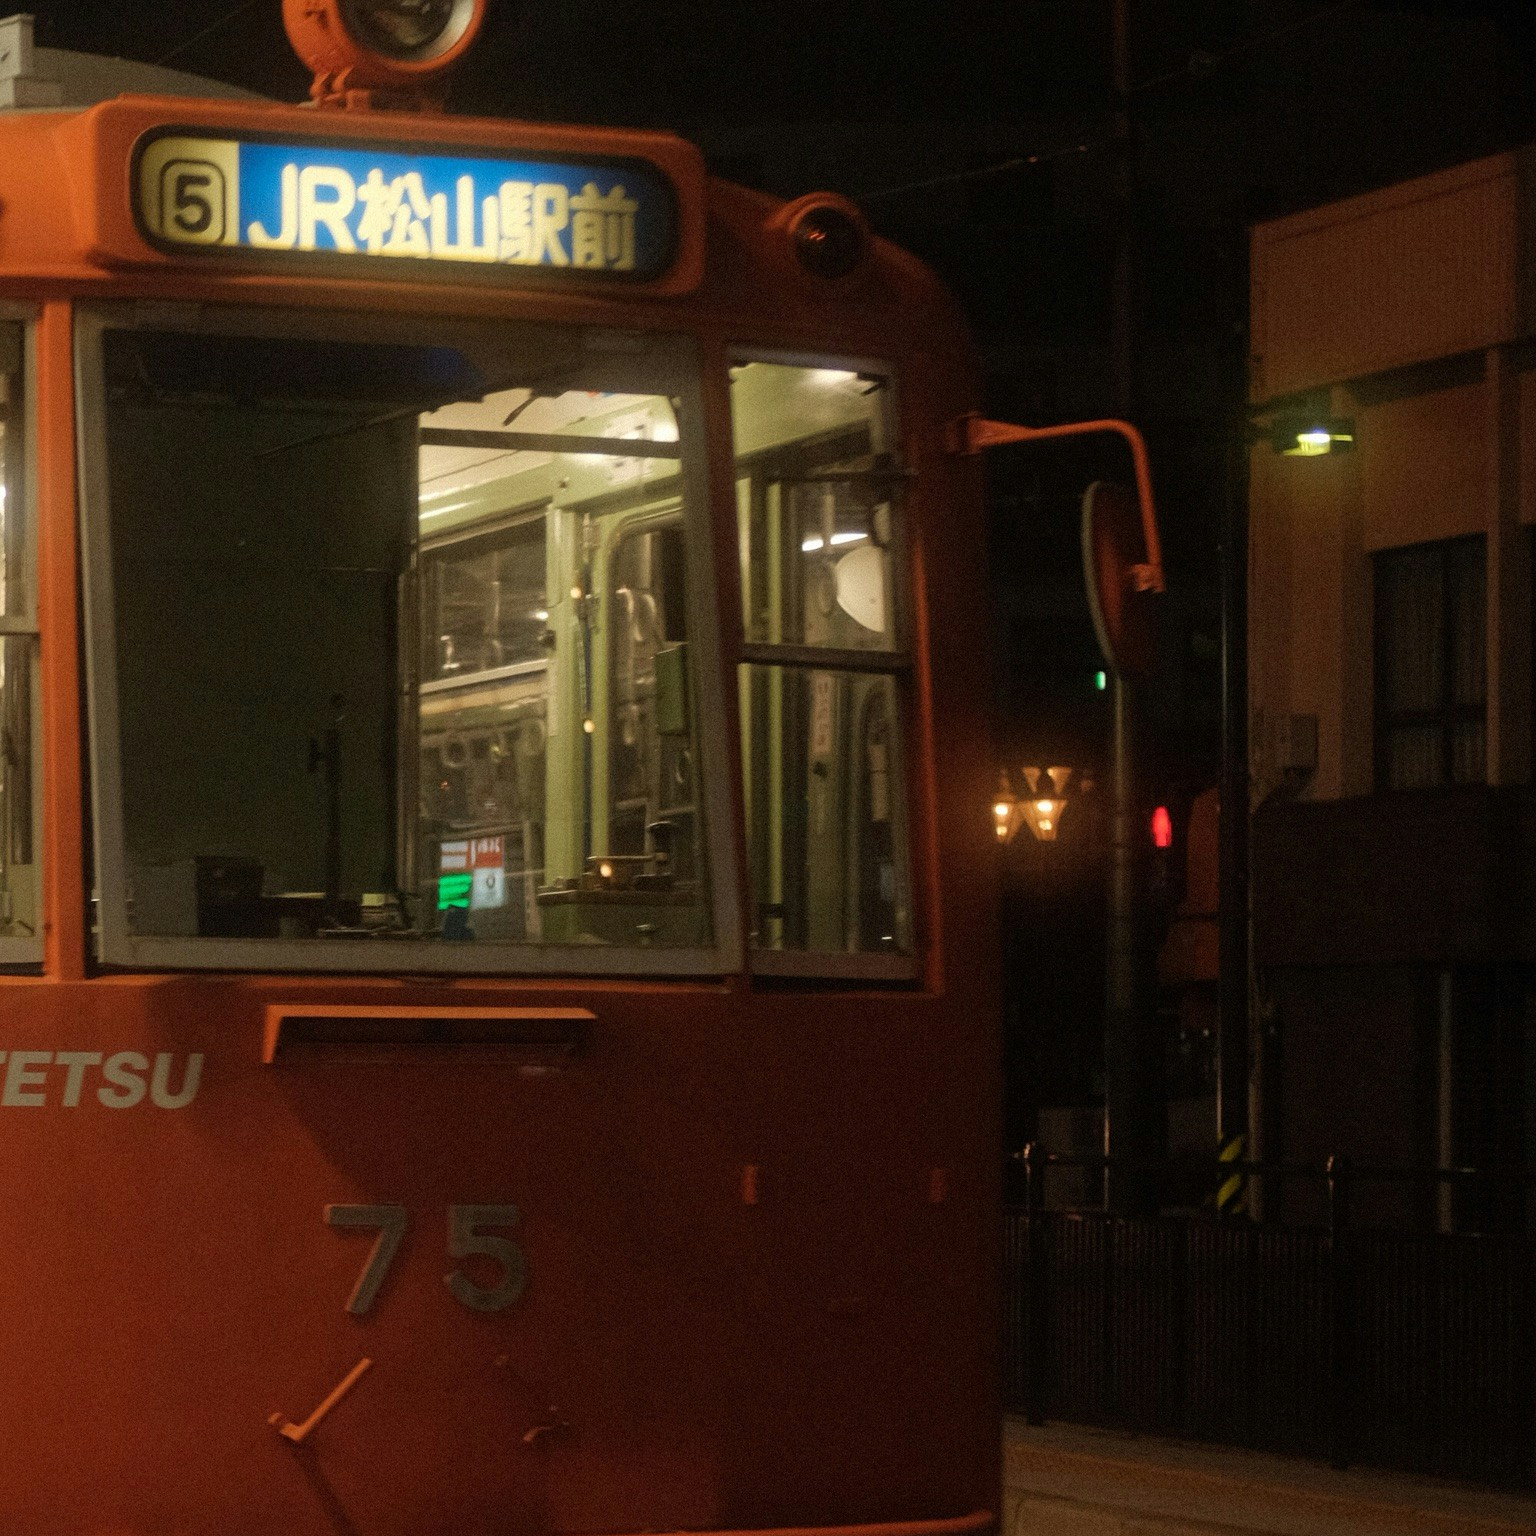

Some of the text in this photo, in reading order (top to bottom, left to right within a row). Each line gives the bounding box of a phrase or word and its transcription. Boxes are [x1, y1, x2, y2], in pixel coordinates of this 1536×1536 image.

[174, 162, 639, 271] 5 JR松山駅前
[324, 1204, 526, 1314] 75
